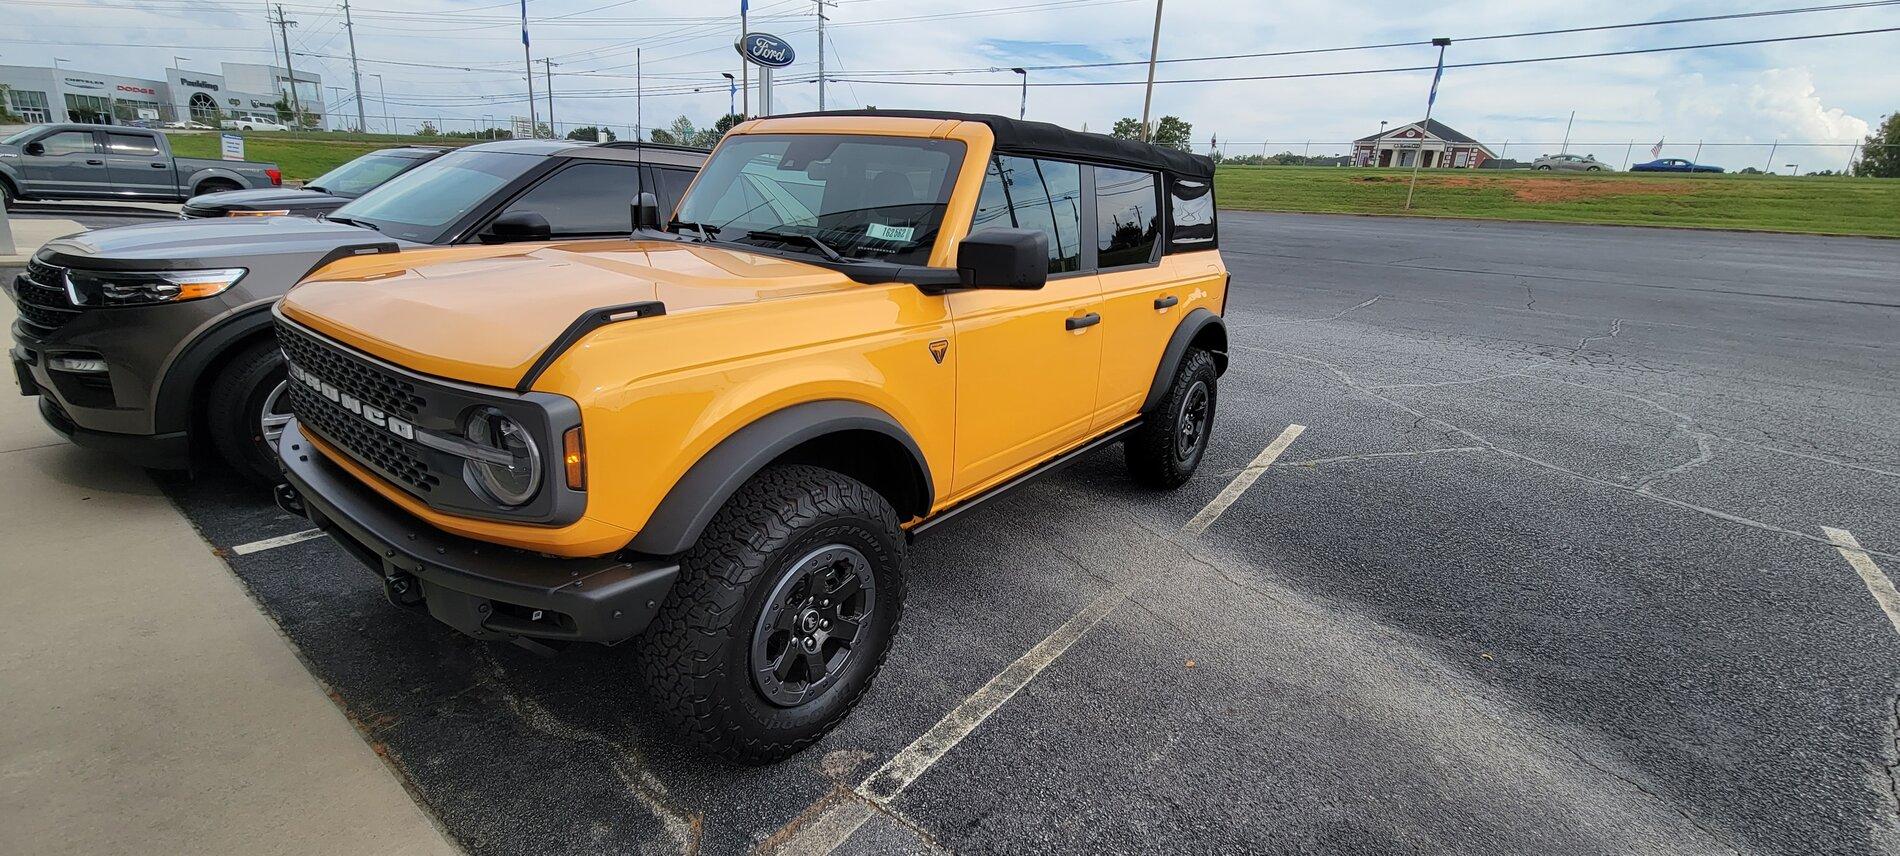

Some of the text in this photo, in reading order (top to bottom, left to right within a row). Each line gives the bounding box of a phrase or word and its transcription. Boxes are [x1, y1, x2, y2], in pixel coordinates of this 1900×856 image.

[753, 38, 785, 61] Ford
[117, 85, 156, 95] DODGE
[290, 362, 413, 440] BRONCO
